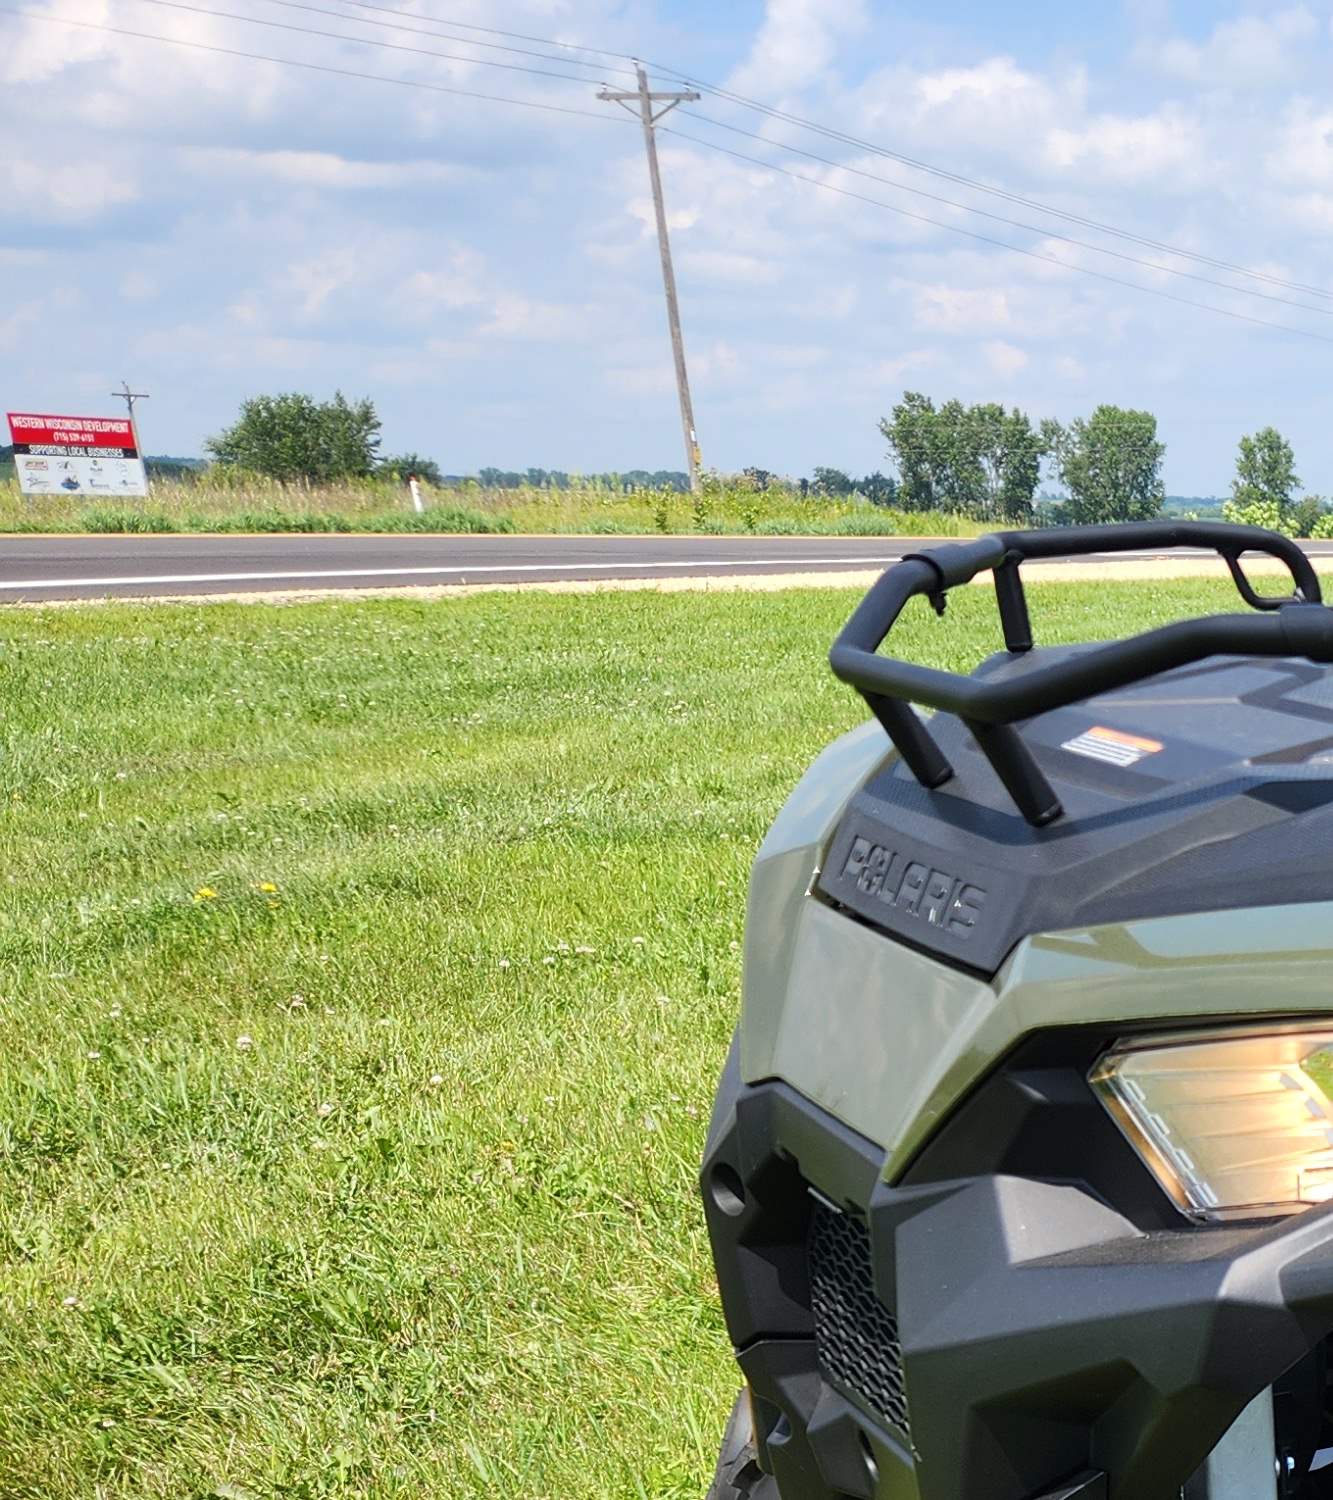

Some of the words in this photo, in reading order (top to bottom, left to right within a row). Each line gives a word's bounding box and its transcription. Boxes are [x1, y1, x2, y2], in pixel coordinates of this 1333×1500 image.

[10, 416, 45, 429] WESTERN
[45, 418, 82, 431] WISCONSIN
[82, 420, 129, 433] DEVELOPMENT
[28, 444, 67, 456] SUPPORTING
[67, 446, 87, 457] LOCAL
[87, 448, 124, 458] BUSINESSES
[839, 834, 988, 941] POLARIS
